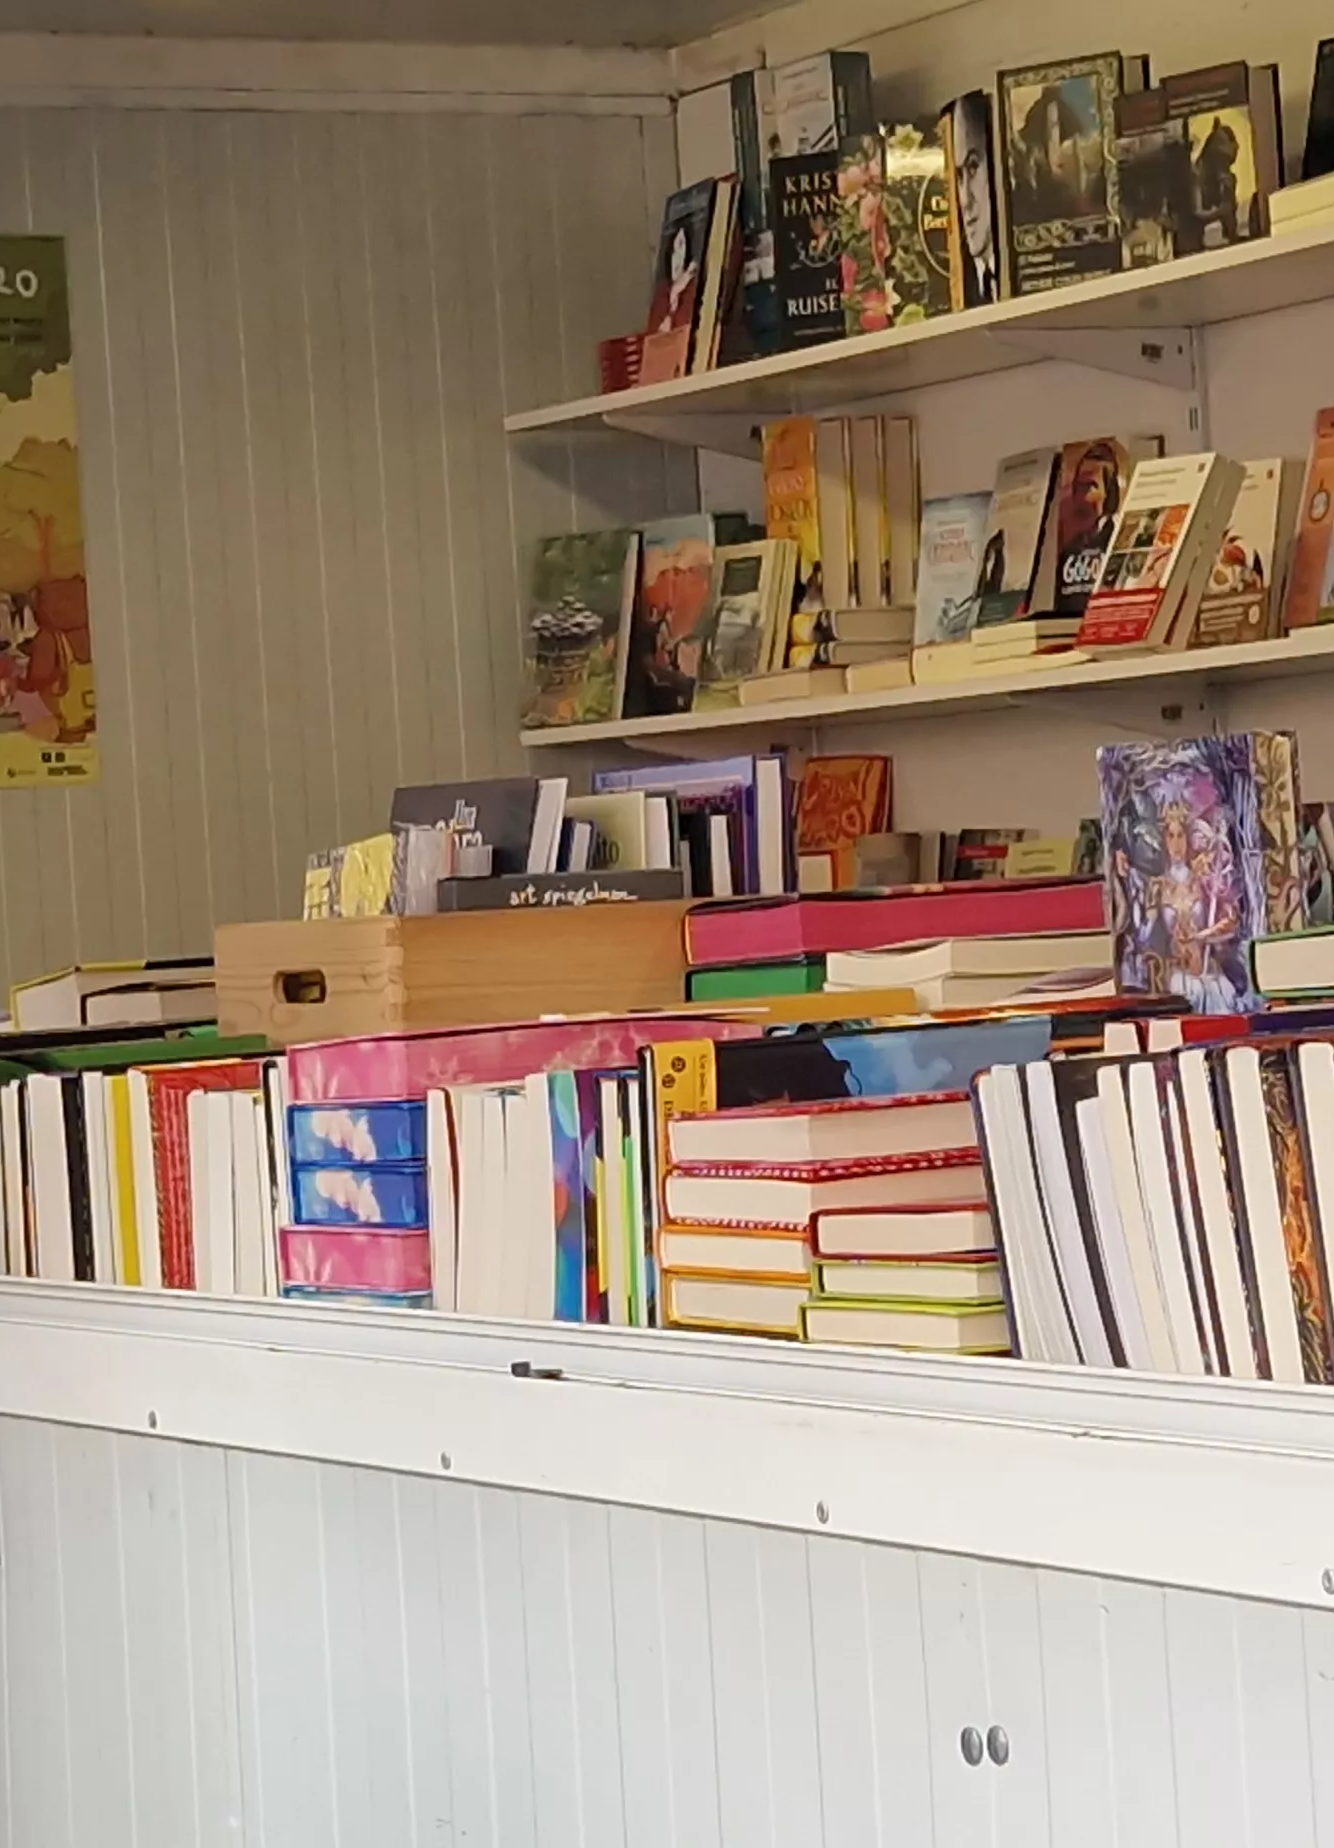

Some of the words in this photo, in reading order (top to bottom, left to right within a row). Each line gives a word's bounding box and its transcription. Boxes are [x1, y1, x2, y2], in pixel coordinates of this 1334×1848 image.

[785, 172, 832, 194] KRIS
[782, 193, 841, 218] HANN
[786, 293, 840, 317] RUISE
